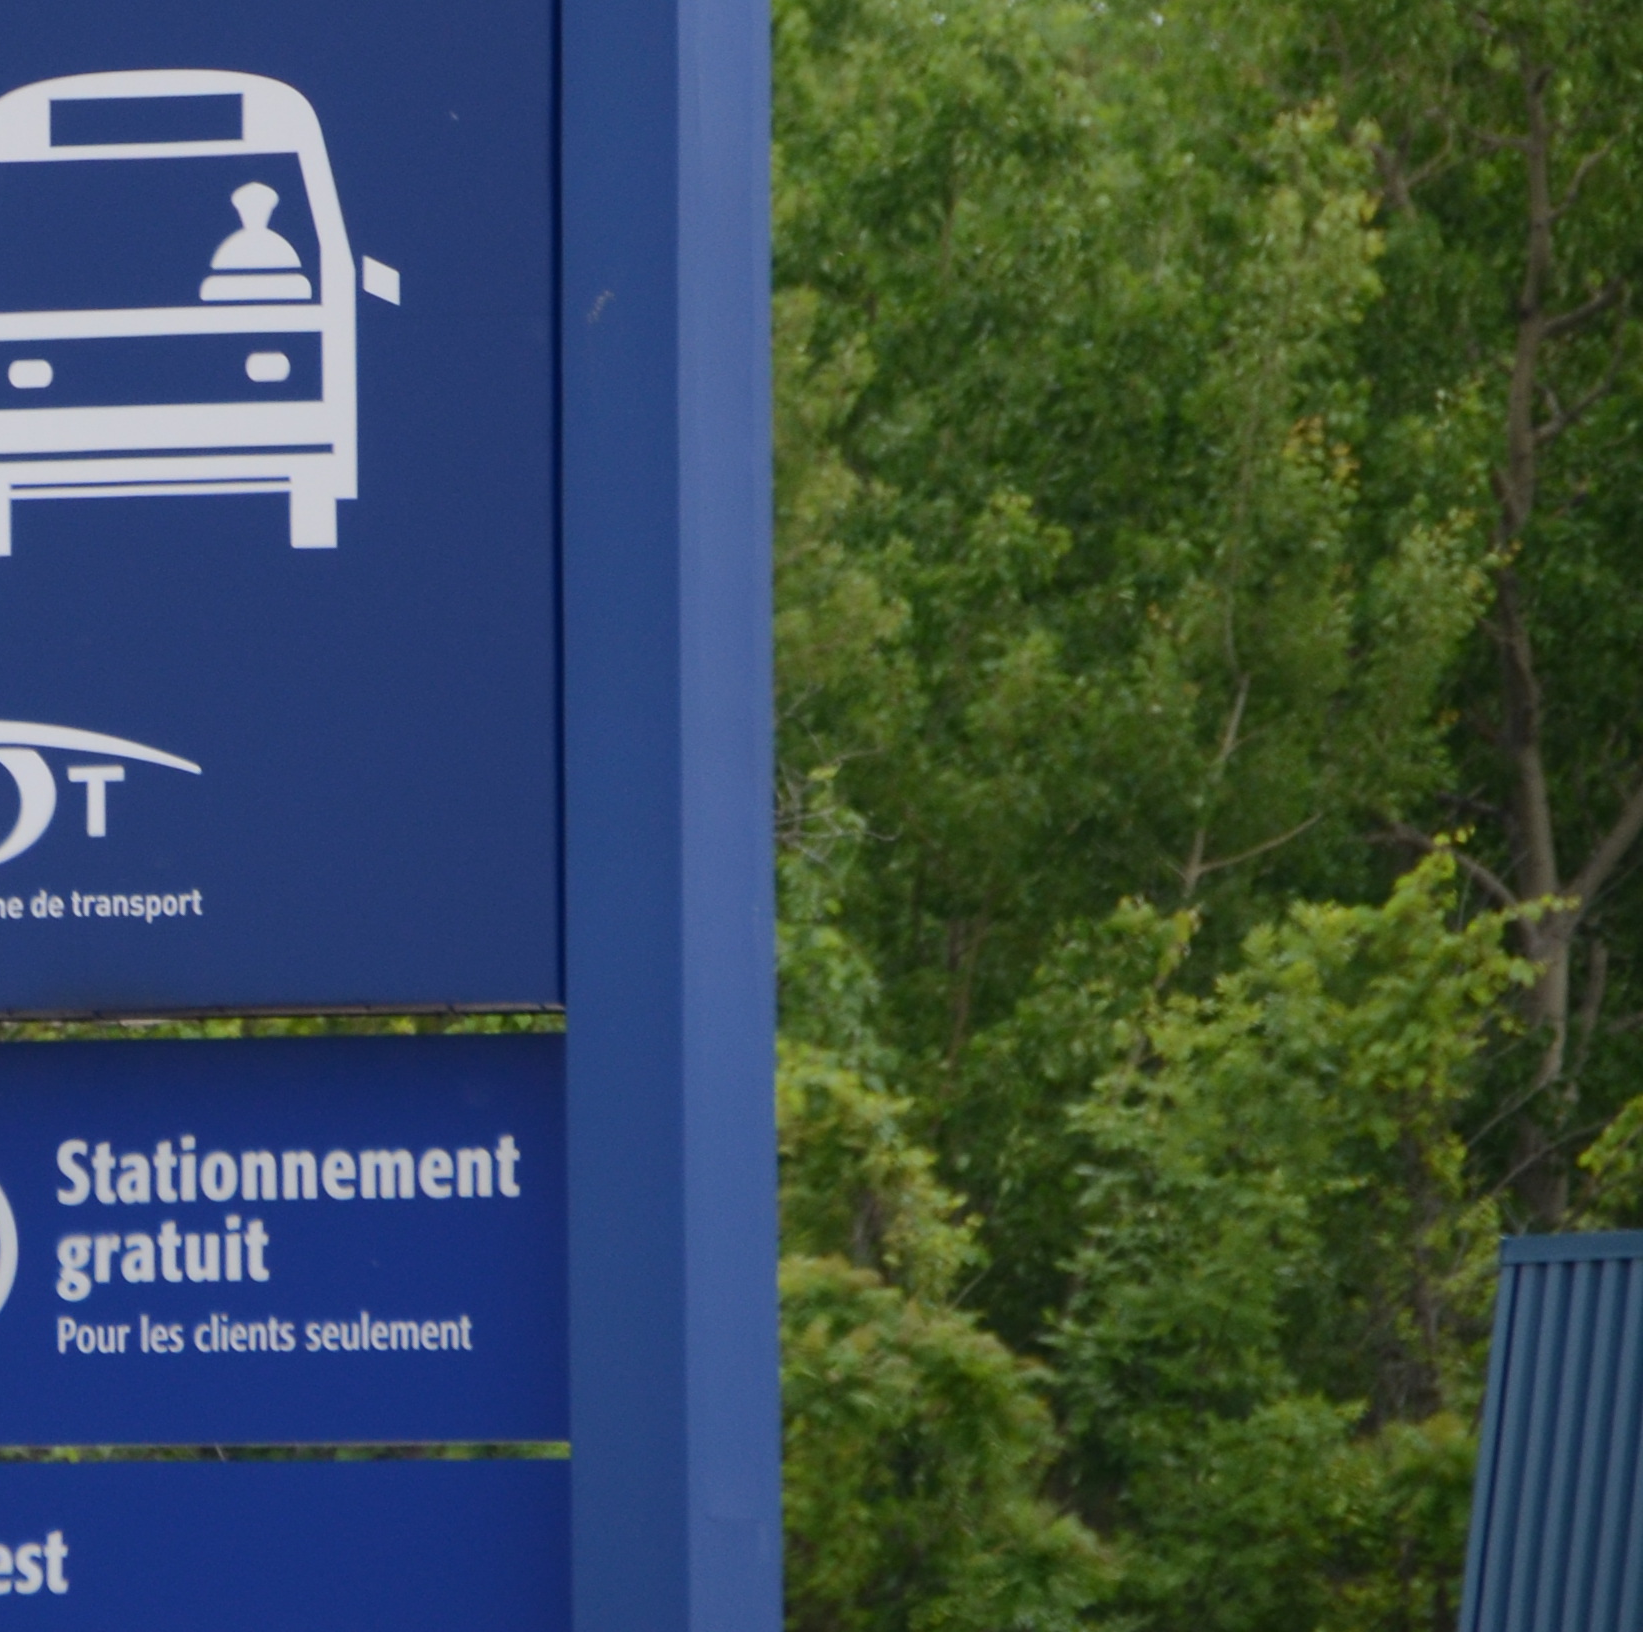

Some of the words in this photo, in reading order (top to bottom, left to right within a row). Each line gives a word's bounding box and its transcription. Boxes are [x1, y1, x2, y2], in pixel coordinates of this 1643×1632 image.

[30, 888, 65, 919] de
[70, 888, 203, 924] transport
[56, 1134, 520, 1205] Stationnement
[56, 1213, 270, 1301] gratuit
[57, 1315, 131, 1354] Pour
[140, 1314, 184, 1353] les
[194, 1313, 296, 1353] clients
[305, 1310, 472, 1351] seulement
